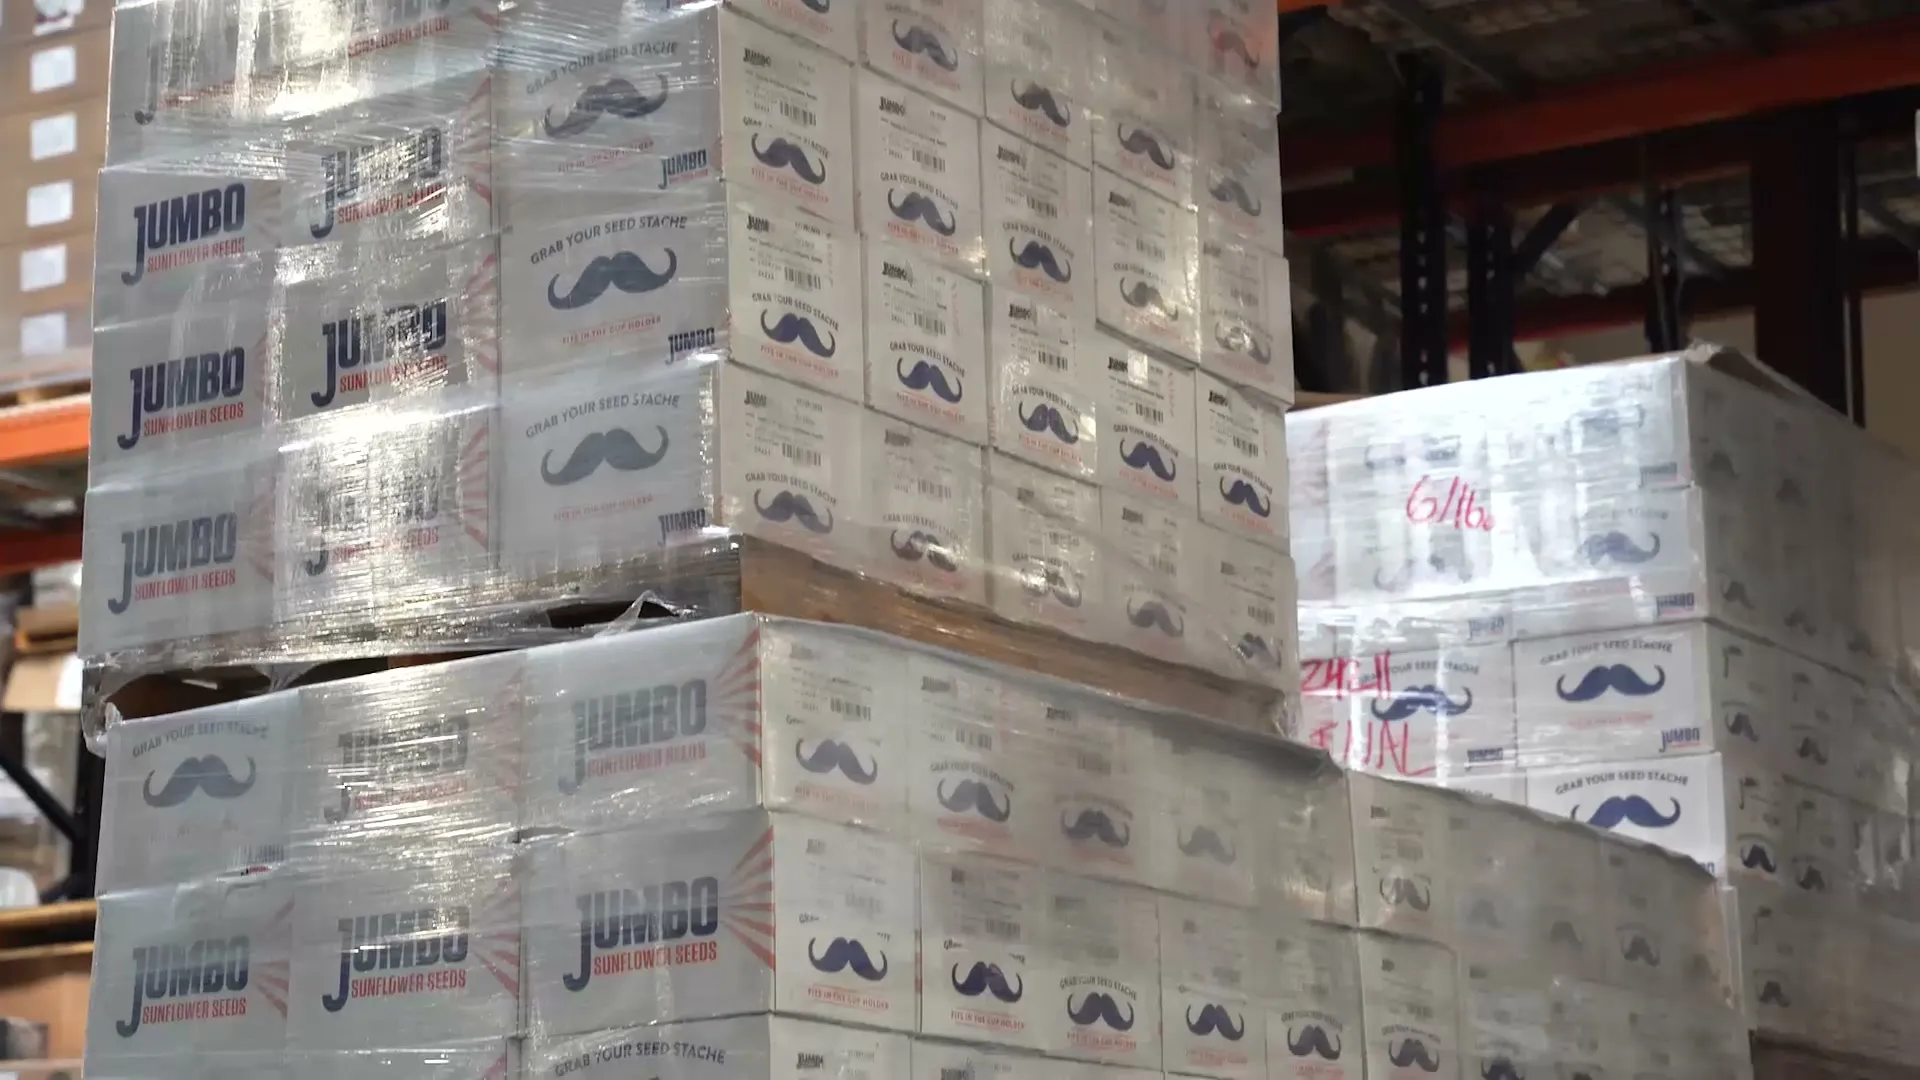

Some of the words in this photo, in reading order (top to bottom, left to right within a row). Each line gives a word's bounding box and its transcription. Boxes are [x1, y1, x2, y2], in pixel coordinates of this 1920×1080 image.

[527, 68, 557, 95] GRAB
[561, 53, 595, 76] YOUR
[597, 46, 628, 65] SEED
[632, 42, 679, 56] STACHE
[658, 149, 707, 190] JUMBO
[121, 183, 245, 286] JUMBO
[531, 243, 564, 265] GRAB
[566, 224, 601, 247] YOUR
[604, 217, 636, 235] SEED
[639, 215, 688, 230] STACHE
[562, 335, 578, 345] FITS
[591, 328, 606, 339] THE
[609, 323, 627, 335] CUP
[628, 315, 662, 331] HOLDER
[665, 327, 715, 365] JUMBO
[117, 347, 245, 450] JUMBO
[525, 418, 559, 439] GRAB
[561, 399, 596, 423] YOUR
[599, 394, 630, 410] SEED
[632, 393, 681, 410] STACHE
[144, 411, 208, 437] SUNFLOWER
[210, 402, 243, 423] SEEDS
[745, 472, 766, 483] GRAB
[767, 472, 788, 485] YOUR
[658, 508, 706, 546] JUMBO
[107, 512, 238, 615] JUMBO
[135, 577, 200, 601] SUNFLOWER
[202, 568, 236, 589] SEEDS
[1443, 662, 1480, 675] TACHE
[132, 737, 162, 757] GRAB
[165, 724, 195, 742] YOUR
[558, 678, 707, 796] JUMBO
[1659, 727, 1701, 753] JUMBO
[1555, 779, 1583, 795] GRAB
[1585, 772, 1615, 787] YOUR
[1617, 771, 1646, 781] SEED
[1648, 771, 1689, 788] STACHE
[563, 876, 719, 992] JUMBO
[322, 906, 470, 1013] JUMBO
[594, 948, 671, 977] SUNFLOWER
[675, 941, 718, 967] SEEDS
[116, 936, 250, 1039] JUMBO
[351, 974, 424, 999] SUNFLOWER
[426, 969, 466, 990] SEEDS
[142, 1000, 209, 1025] SUNFLOWER
[212, 997, 246, 1019] SEEDS
[863, 998, 889, 1009] HOLDER
[555, 1052, 590, 1077] GRAB
[594, 1041, 632, 1064] YOUR
[634, 1040, 670, 1057] SEED
[672, 1042, 726, 1064] STACHE
